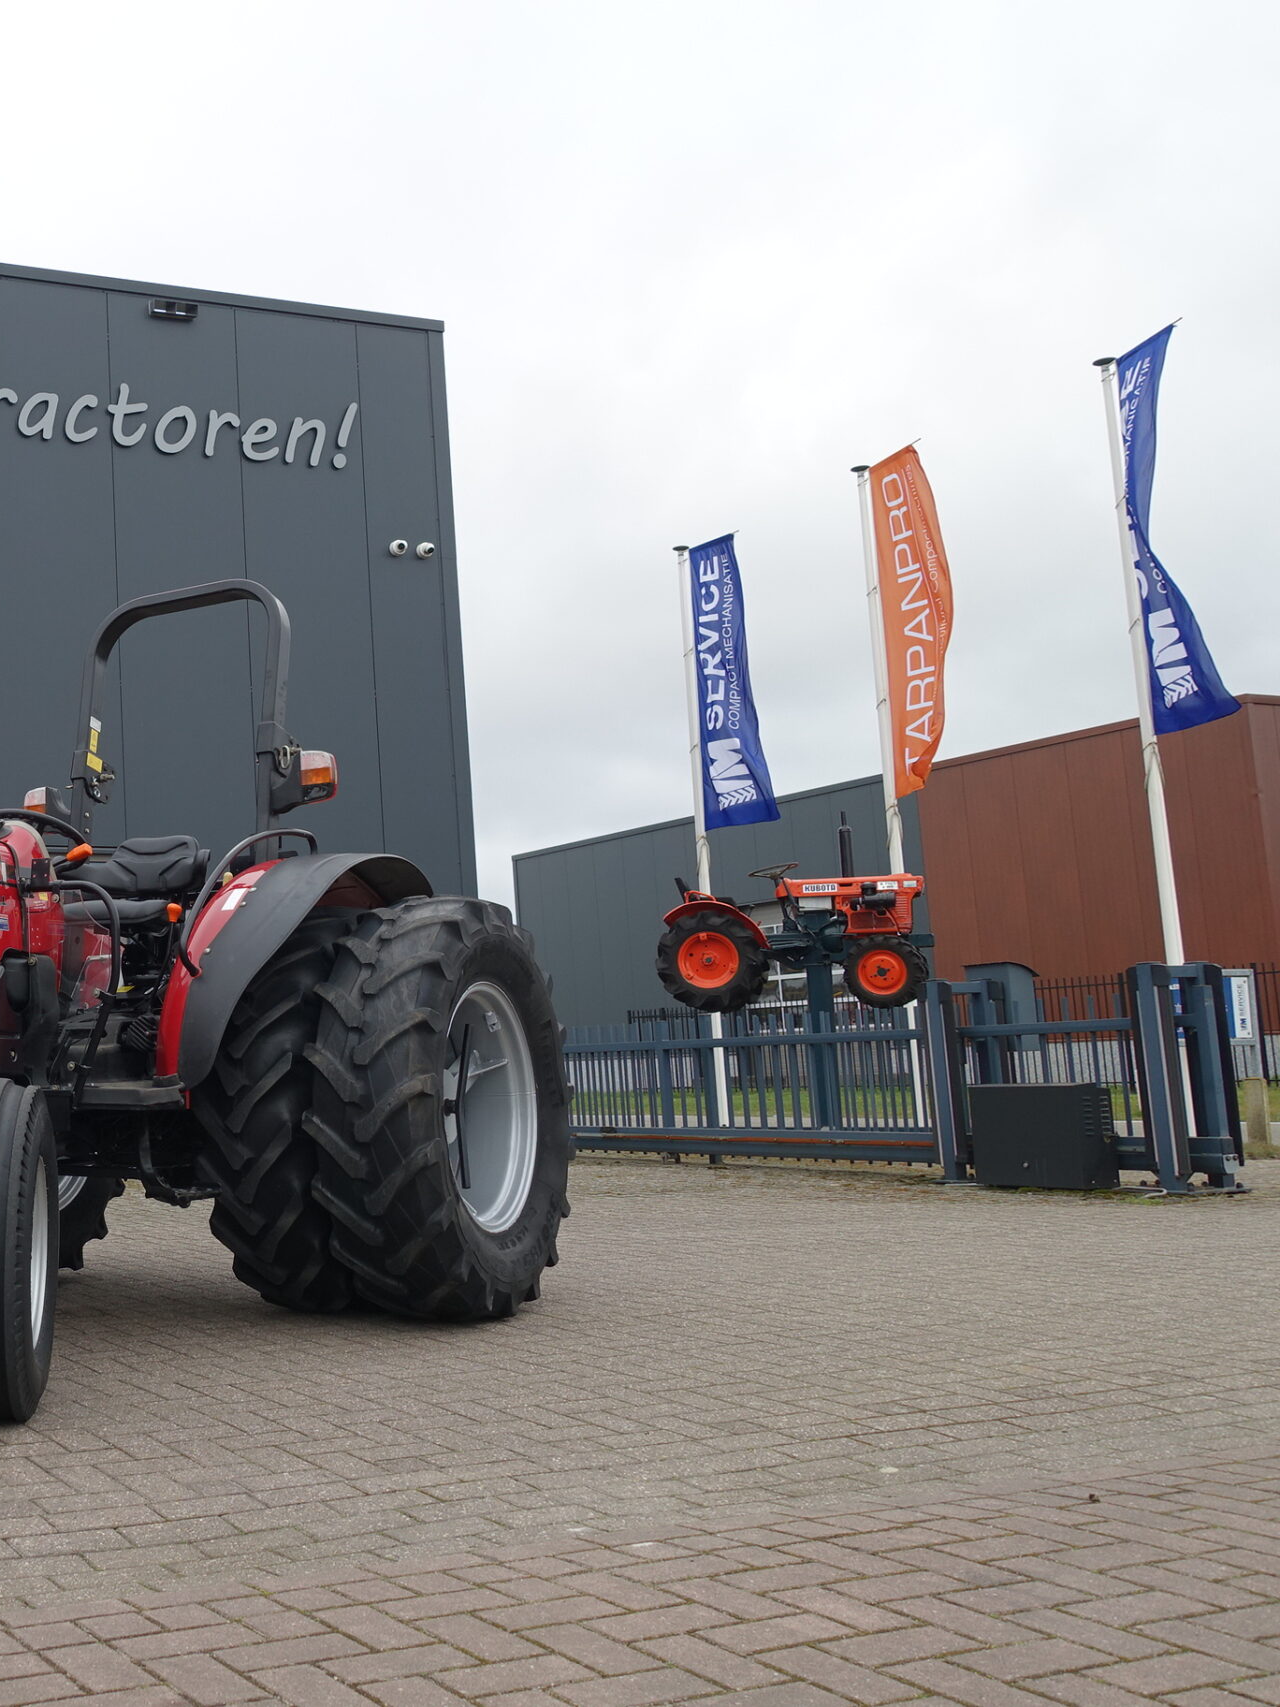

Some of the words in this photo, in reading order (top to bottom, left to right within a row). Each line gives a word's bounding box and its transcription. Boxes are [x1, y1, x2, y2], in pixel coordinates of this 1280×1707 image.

[698, 555, 726, 731] SERVICE
[720, 553, 735, 660] MECHANISATIE
[881, 472, 936, 777] TARPANPRO
[726, 662, 742, 730] COMPACT
[804, 884, 836, 892] KUBOTA
